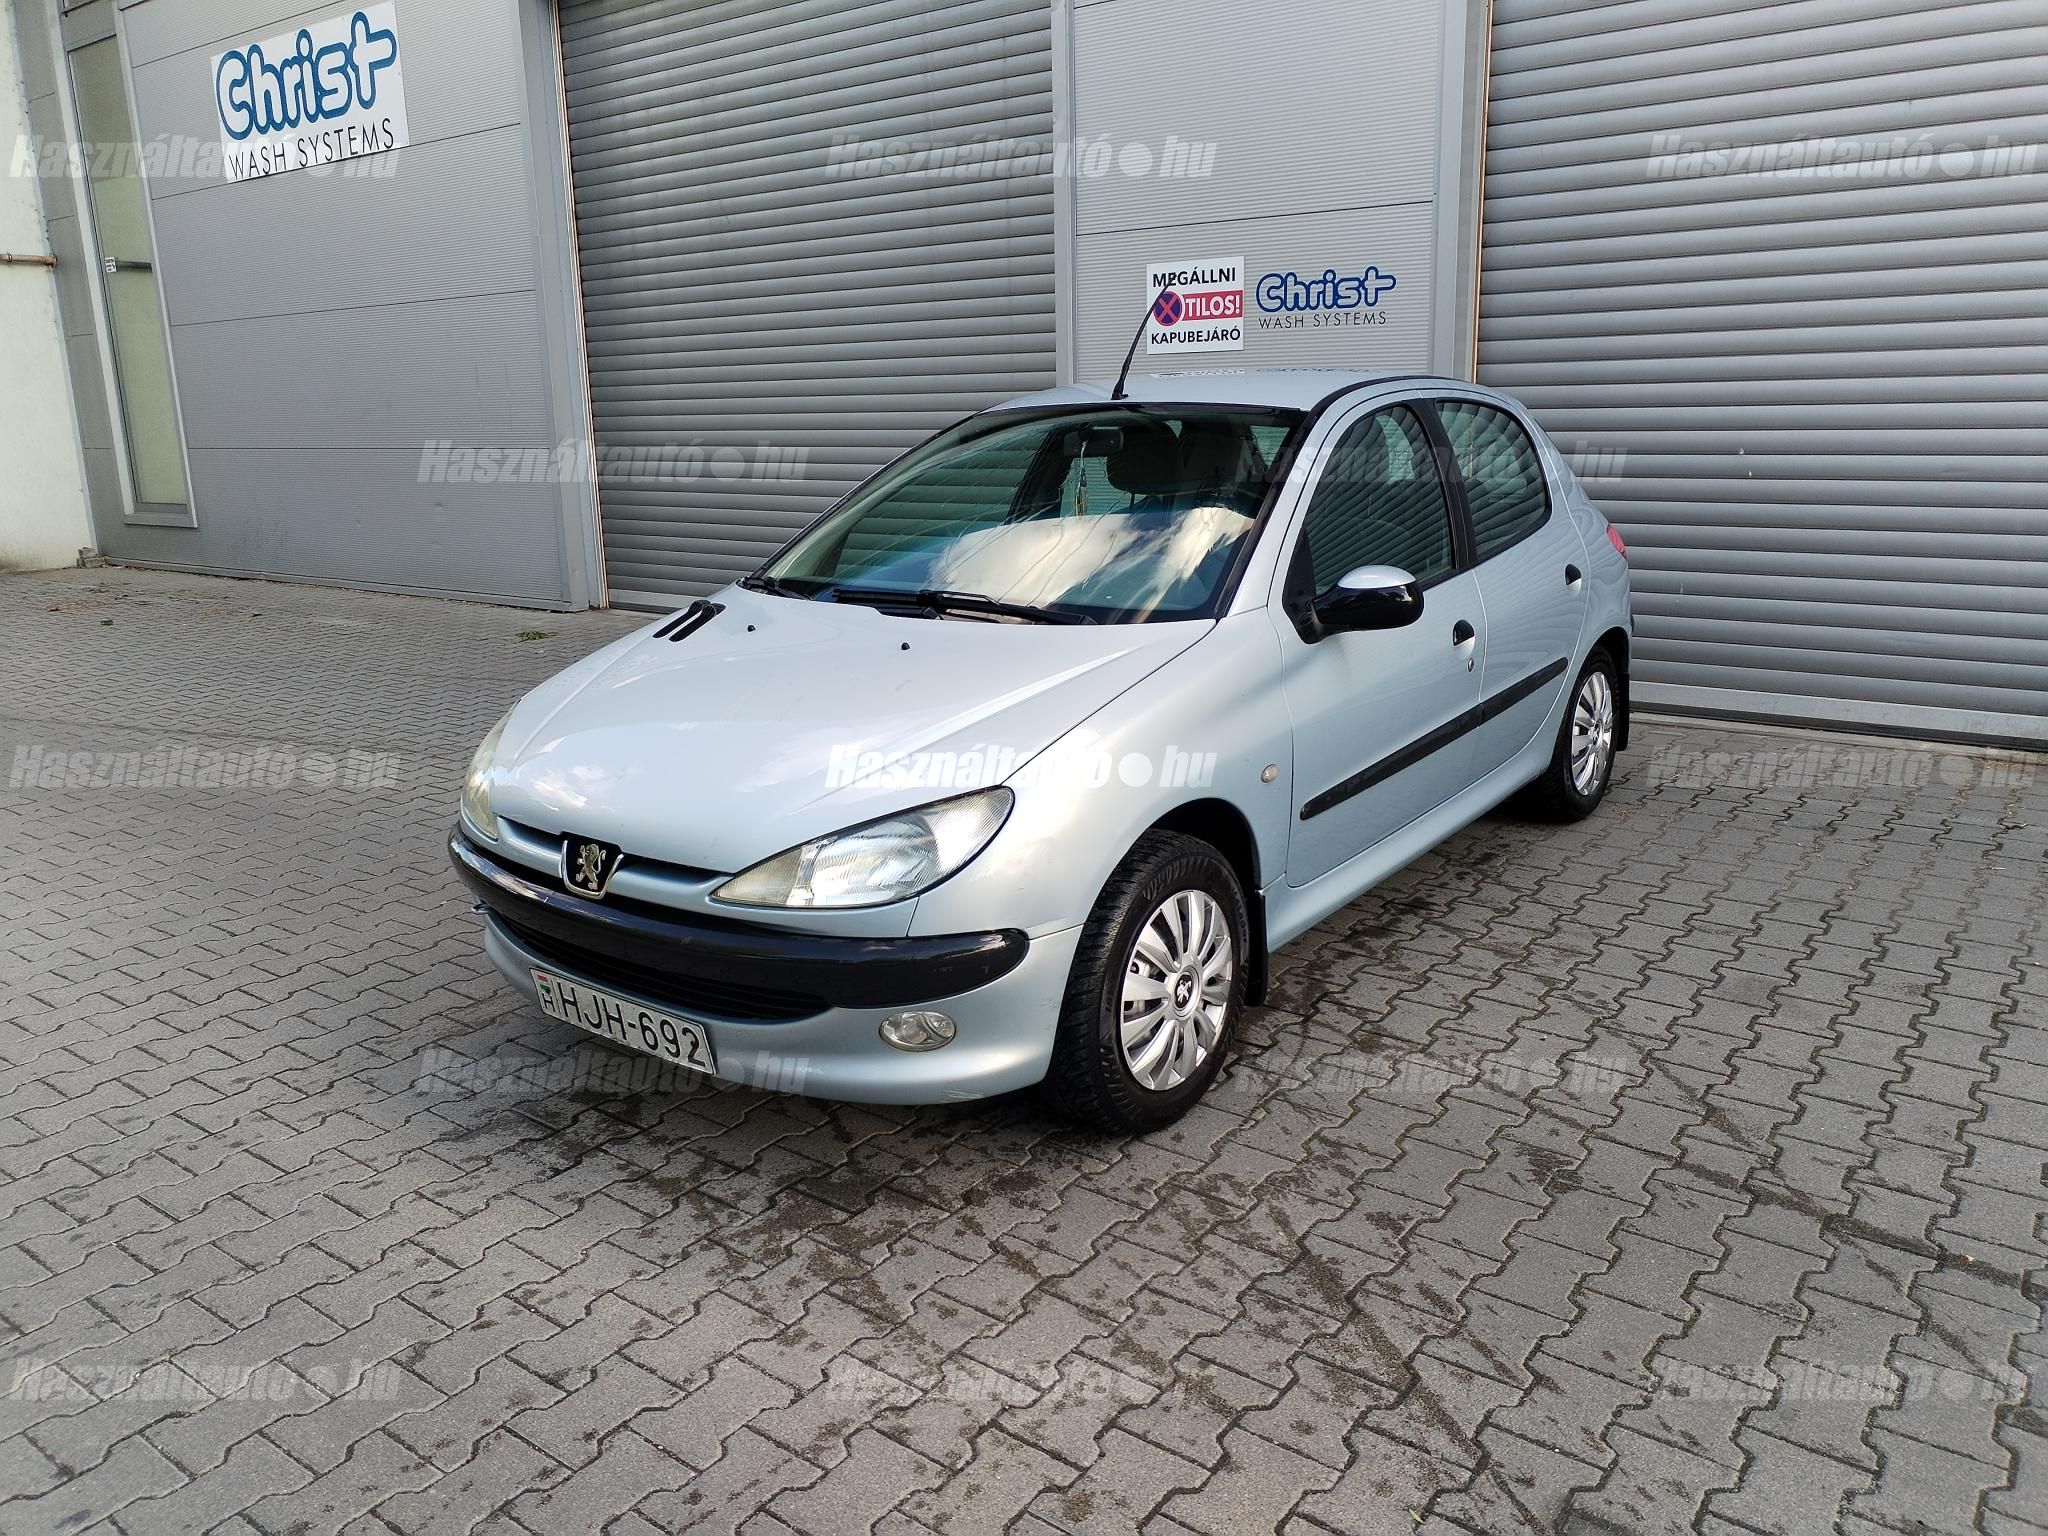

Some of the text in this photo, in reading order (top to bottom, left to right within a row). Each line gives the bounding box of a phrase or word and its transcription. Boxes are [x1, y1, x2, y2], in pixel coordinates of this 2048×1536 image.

[216, 11, 397, 140] Christ
[229, 117, 395, 181] WASH SYSTEMS
[1153, 266, 1236, 288] MEGÁLLNI
[1256, 266, 1397, 313] Christ
[1185, 294, 1240, 318] TILOS!
[1258, 310, 1387, 330] WASH SYSTEMS
[1151, 325, 1241, 345] KAPUBEJÁRÓ
[557, 982, 706, 1067] HJH-692
